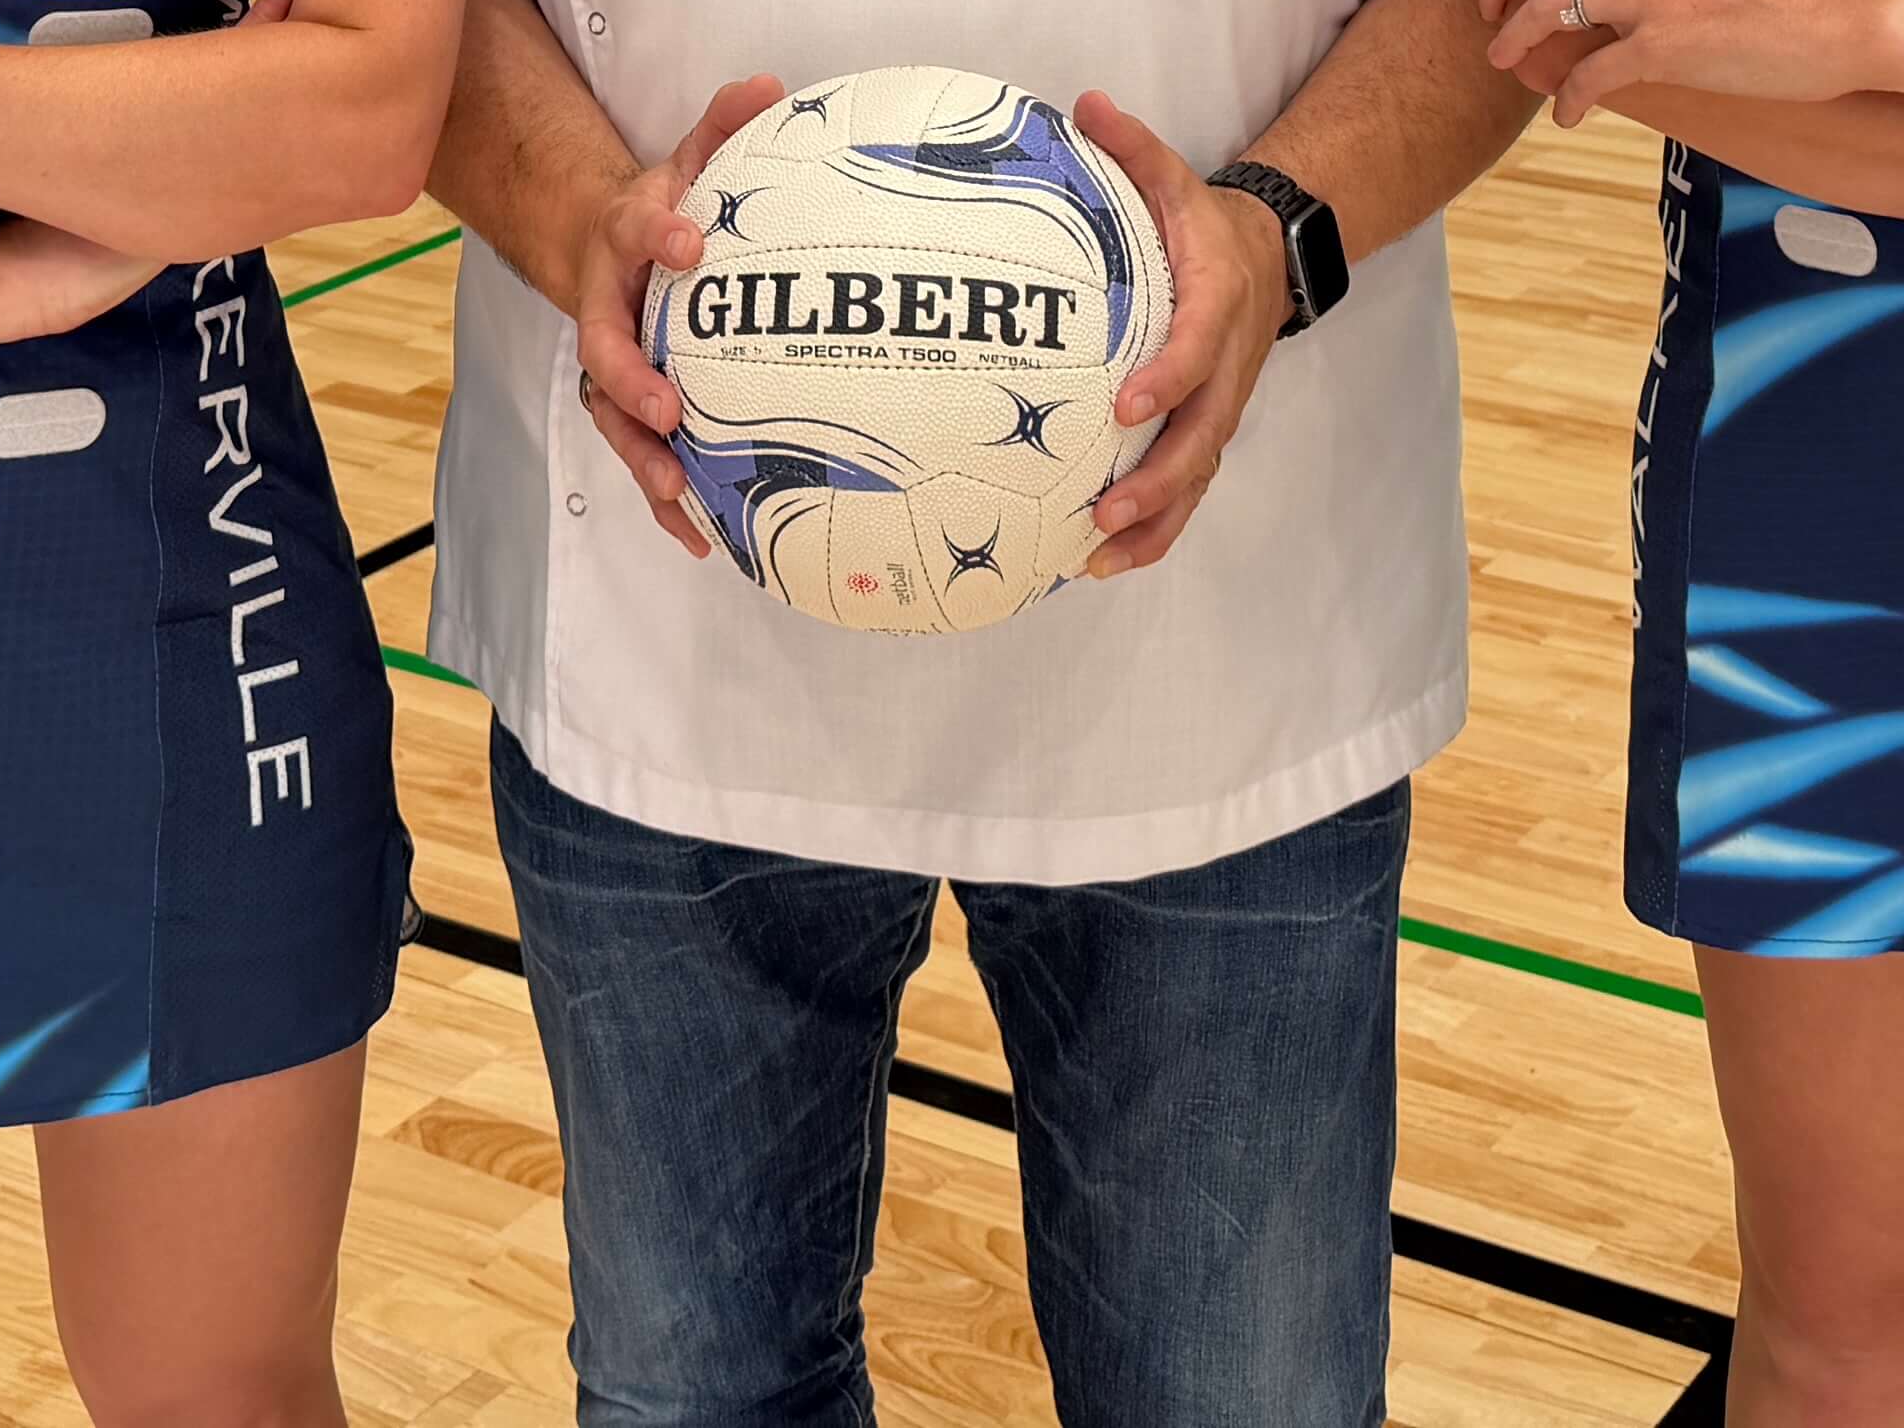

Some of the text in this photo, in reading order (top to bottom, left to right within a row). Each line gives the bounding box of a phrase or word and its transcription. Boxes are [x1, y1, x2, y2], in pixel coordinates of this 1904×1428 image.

[688, 271, 1076, 351] GILBERT
[785, 344, 888, 359] SPECTRA
[897, 347, 957, 364] T500
